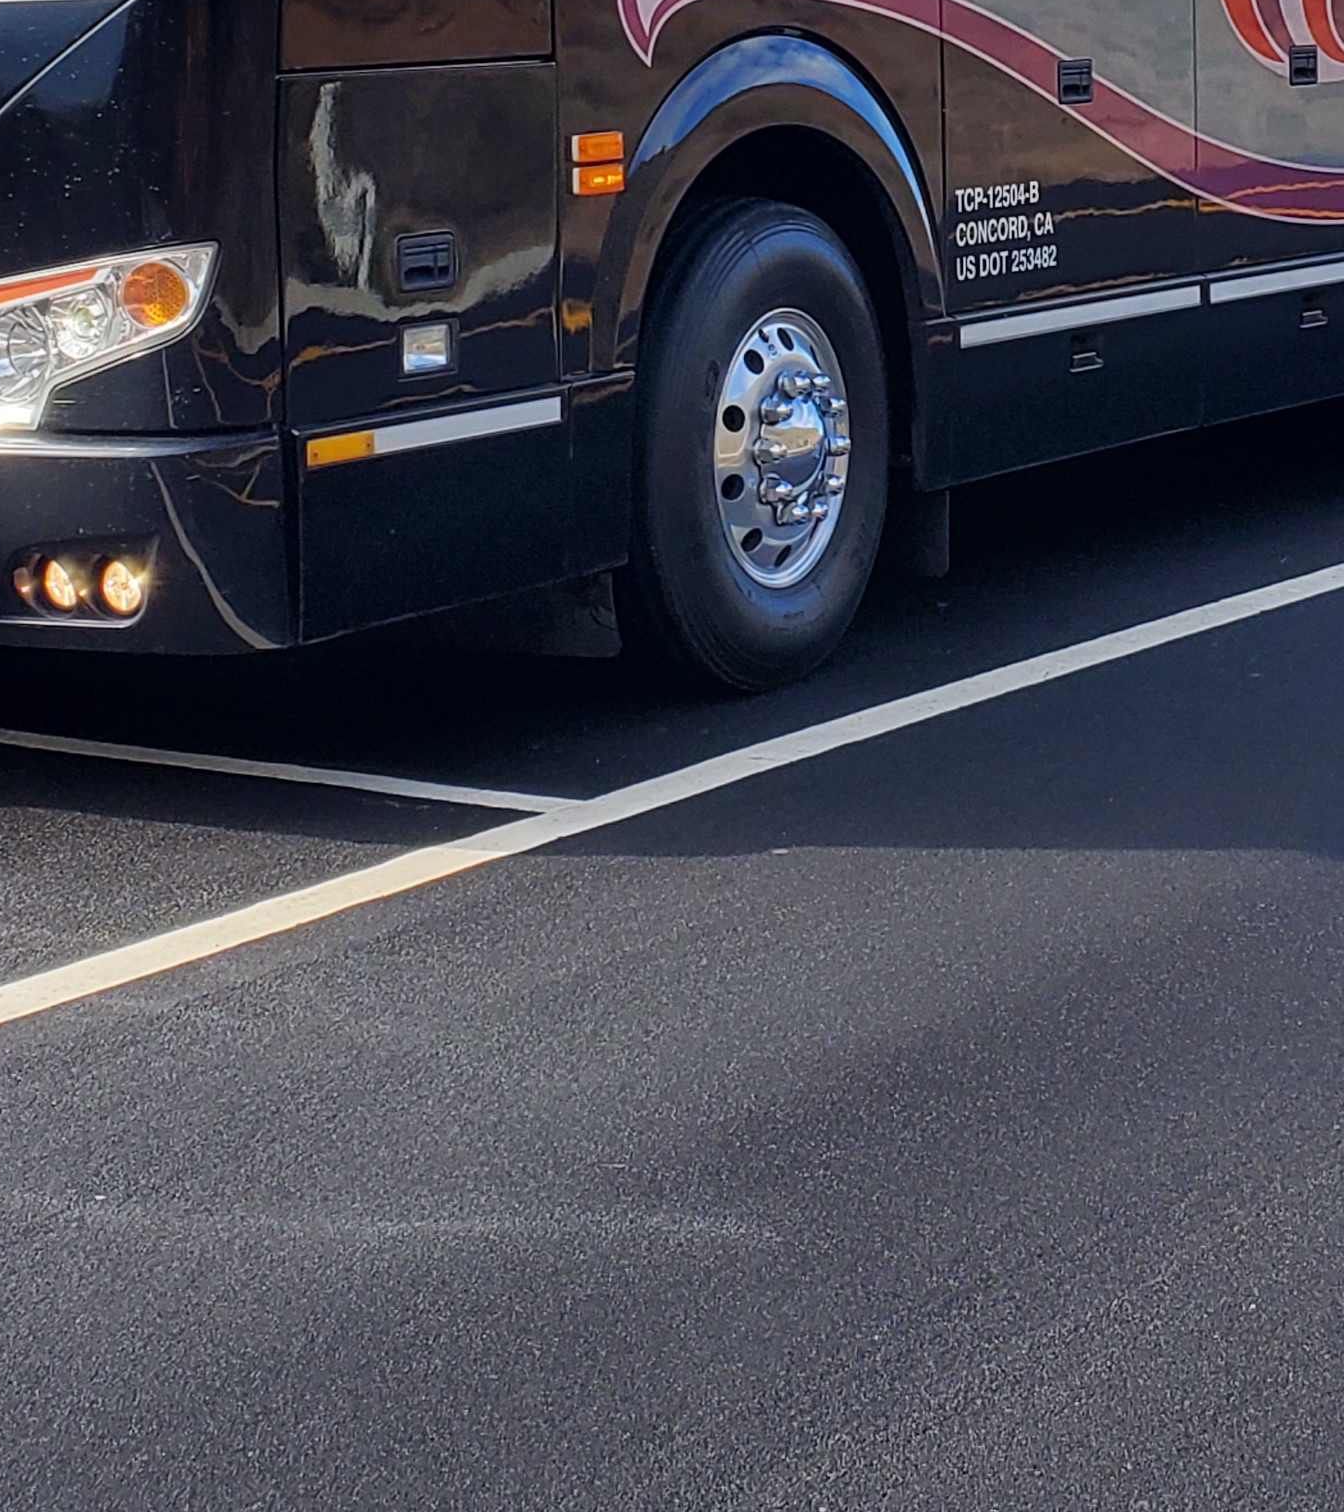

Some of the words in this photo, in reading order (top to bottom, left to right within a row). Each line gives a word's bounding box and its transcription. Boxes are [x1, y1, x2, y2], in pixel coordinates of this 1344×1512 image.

[955, 181, 1039, 213] TCP-12504-B
[956, 215, 1031, 247] CONCORD,
[1034, 212, 1054, 236] CA
[957, 255, 976, 281] US
[979, 250, 1009, 277] DOT
[1011, 245, 1057, 272] 253482
